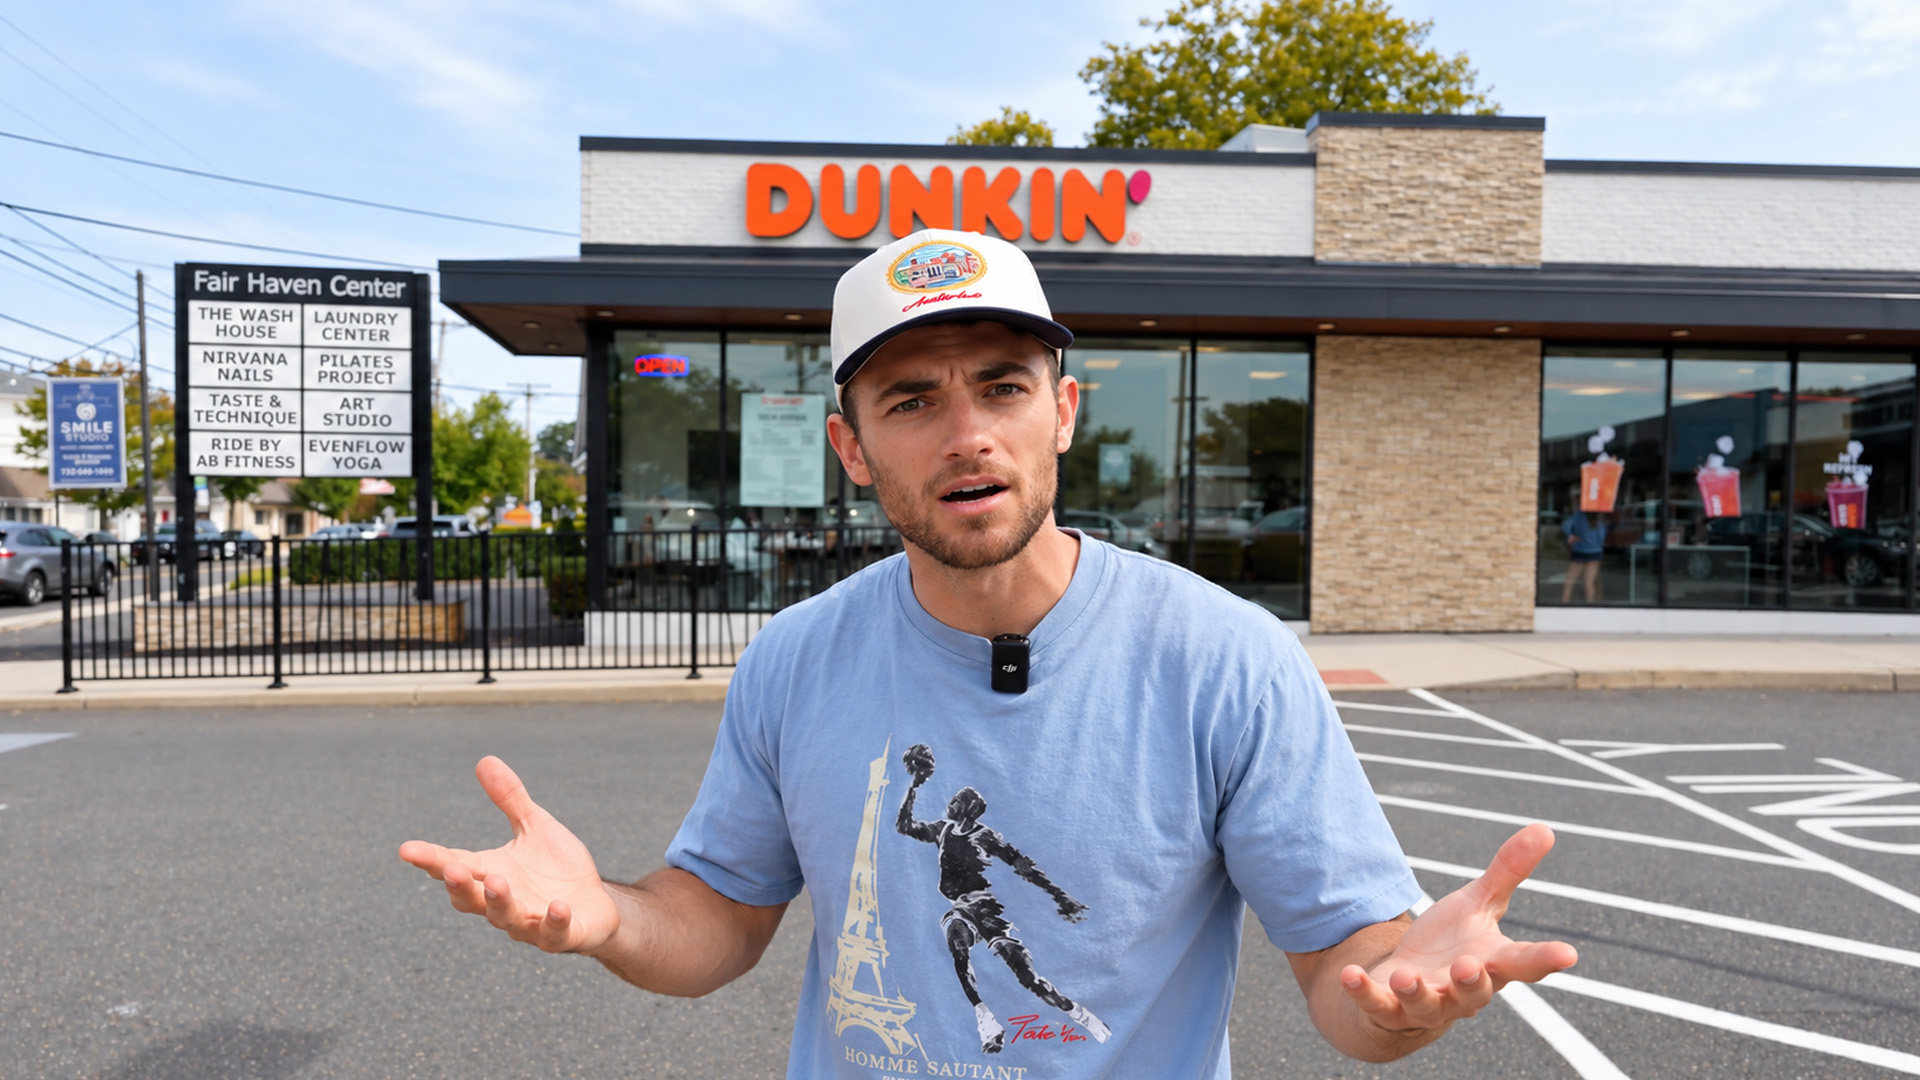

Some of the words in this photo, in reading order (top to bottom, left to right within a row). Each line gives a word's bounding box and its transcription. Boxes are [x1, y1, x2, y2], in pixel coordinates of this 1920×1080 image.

[746, 163, 1151, 243] DUNKIN'
[194, 270, 240, 292] Fair
[247, 272, 322, 296] Haven
[329, 274, 407, 298] Center
[198, 307, 232, 321] THE
[239, 308, 294, 323] WASH
[314, 311, 398, 325] LAUNDRY
[216, 324, 277, 339] HOUSE
[322, 327, 390, 342] CENTER
[203, 351, 288, 366] NIRVANA
[320, 354, 394, 368] PILATES
[635, 357, 685, 374] OPEN
[218, 368, 273, 382] NAILS
[318, 371, 396, 385] PROJECT
[210, 394, 263, 408] TASTE
[270, 395, 281, 408] &
[340, 397, 375, 411] ART
[195, 410, 297, 427] TECHNIQUE
[323, 413, 392, 427] STUDIO
[61, 421, 113, 433] SMILE
[65, 433, 109, 442] STUDIO
[211, 438, 253, 451] RIDE
[259, 439, 281, 452] BY
[309, 439, 405, 454] EVENFLOW
[196, 455, 219, 468] AB
[225, 455, 295, 469] FITNESS
[332, 456, 382, 471] YOGA
[844, 1045, 919, 1074] HOMME
[926, 1060, 1028, 1080] SAUTANT
